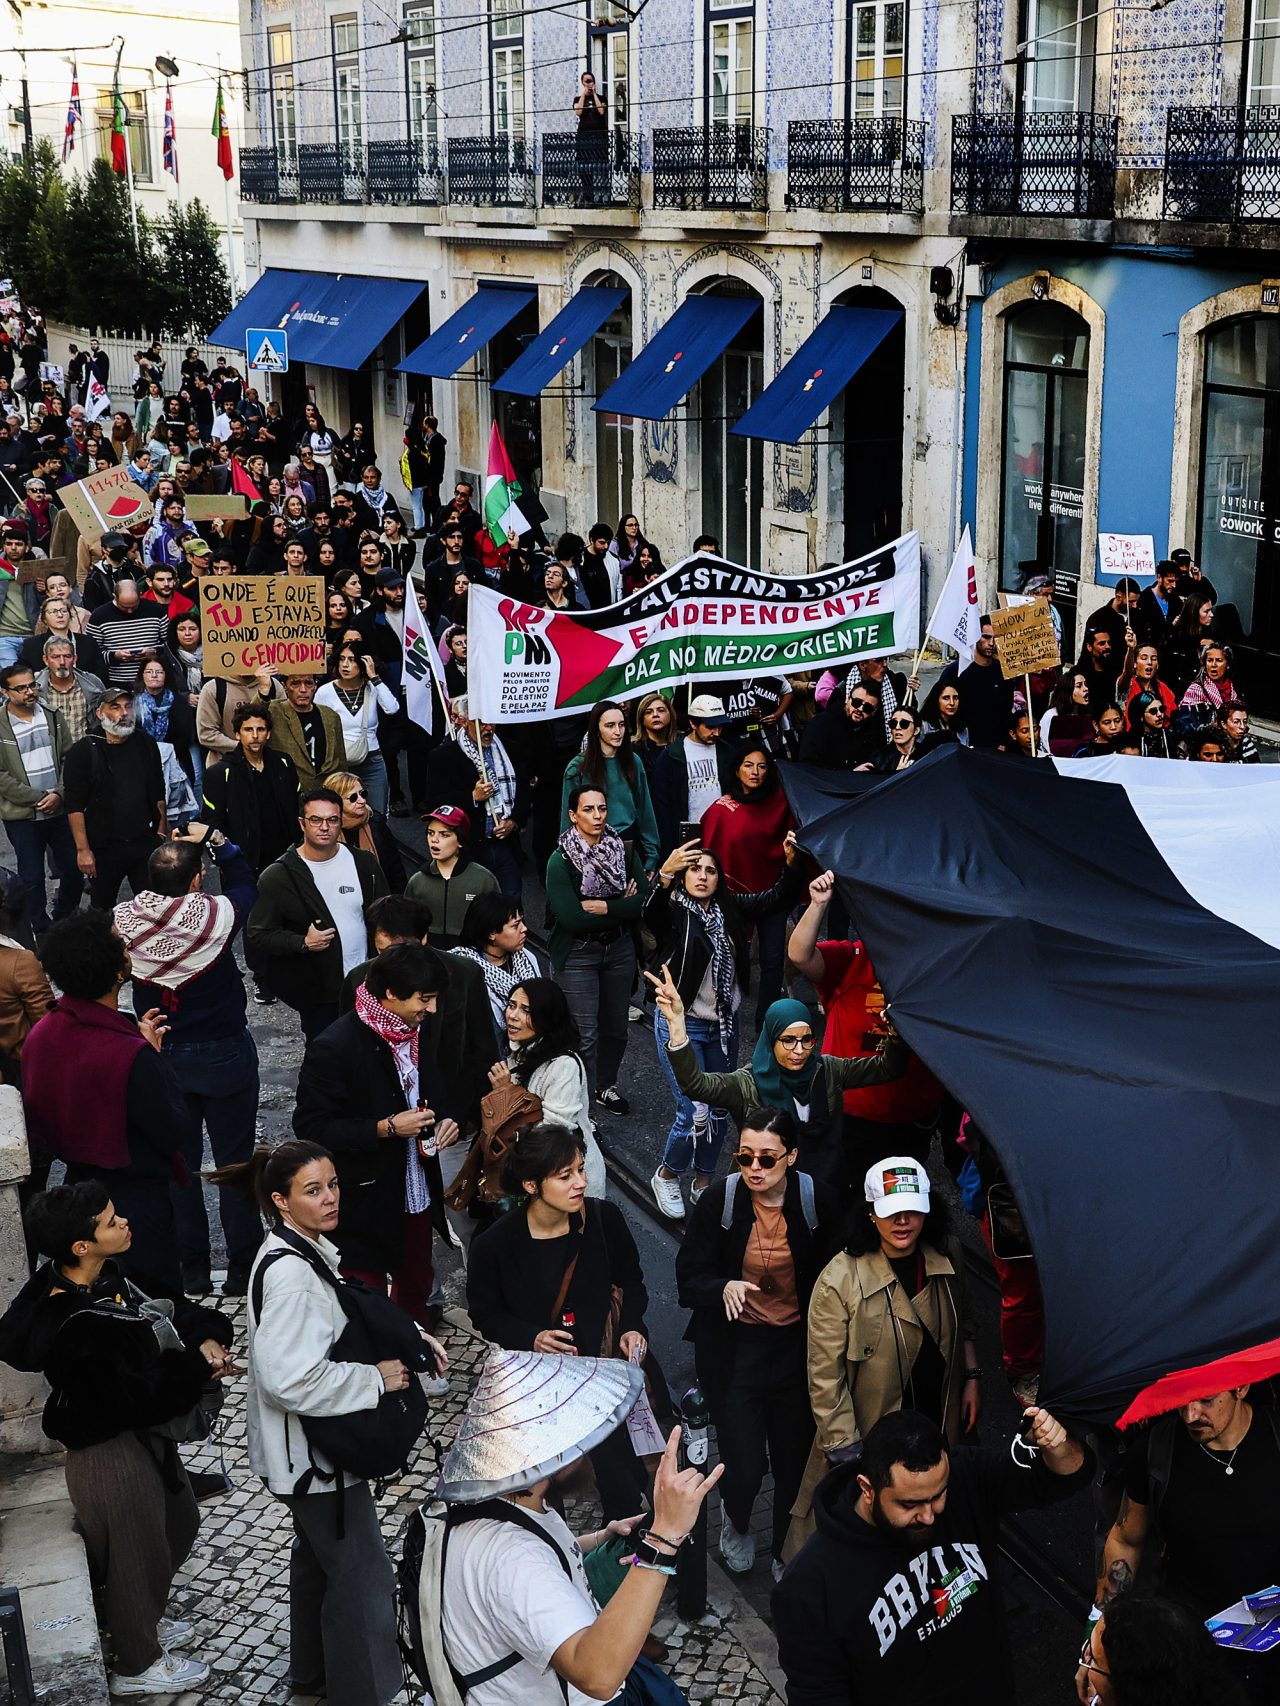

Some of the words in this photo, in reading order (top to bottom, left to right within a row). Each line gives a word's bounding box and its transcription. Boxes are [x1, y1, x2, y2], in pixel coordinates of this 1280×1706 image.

[1263, 289, 1278, 303] 107
[88, 471, 129, 496] 11470
[1024, 484, 1042, 495] work
[1028, 499, 1042, 510] live
[1221, 495, 1265, 512] OUTSITE
[1220, 517, 1263, 535] cowork
[1108, 536, 1142, 552] STOP
[1104, 557, 1154, 571] SLAUGHTER
[203, 582, 257, 602] ONDE
[266, 578, 277, 603] É
[285, 584, 316, 604] QUE
[206, 603, 243, 628] TU
[252, 604, 323, 625] ESTAVAS
[629, 626, 648, 649] E
[653, 587, 882, 634] NDEPENDENTE
[997, 611, 1026, 629] HOW
[207, 626, 259, 643] QUANDO
[266, 624, 327, 640] ACONTECEU
[1002, 630, 1017, 642] YOU
[221, 652, 236, 668] O
[624, 652, 661, 685] PAZ
[669, 643, 696, 670] NO
[704, 641, 777, 666] MÉDIO
[783, 624, 880, 658] ORIENTE
[503, 671, 551, 679] MOVIMENTO
[502, 686, 518, 694] DO
[521, 685, 549, 694] POVO
[502, 693, 548, 701] PALESTINO
[532, 701, 547, 709] PAZ
